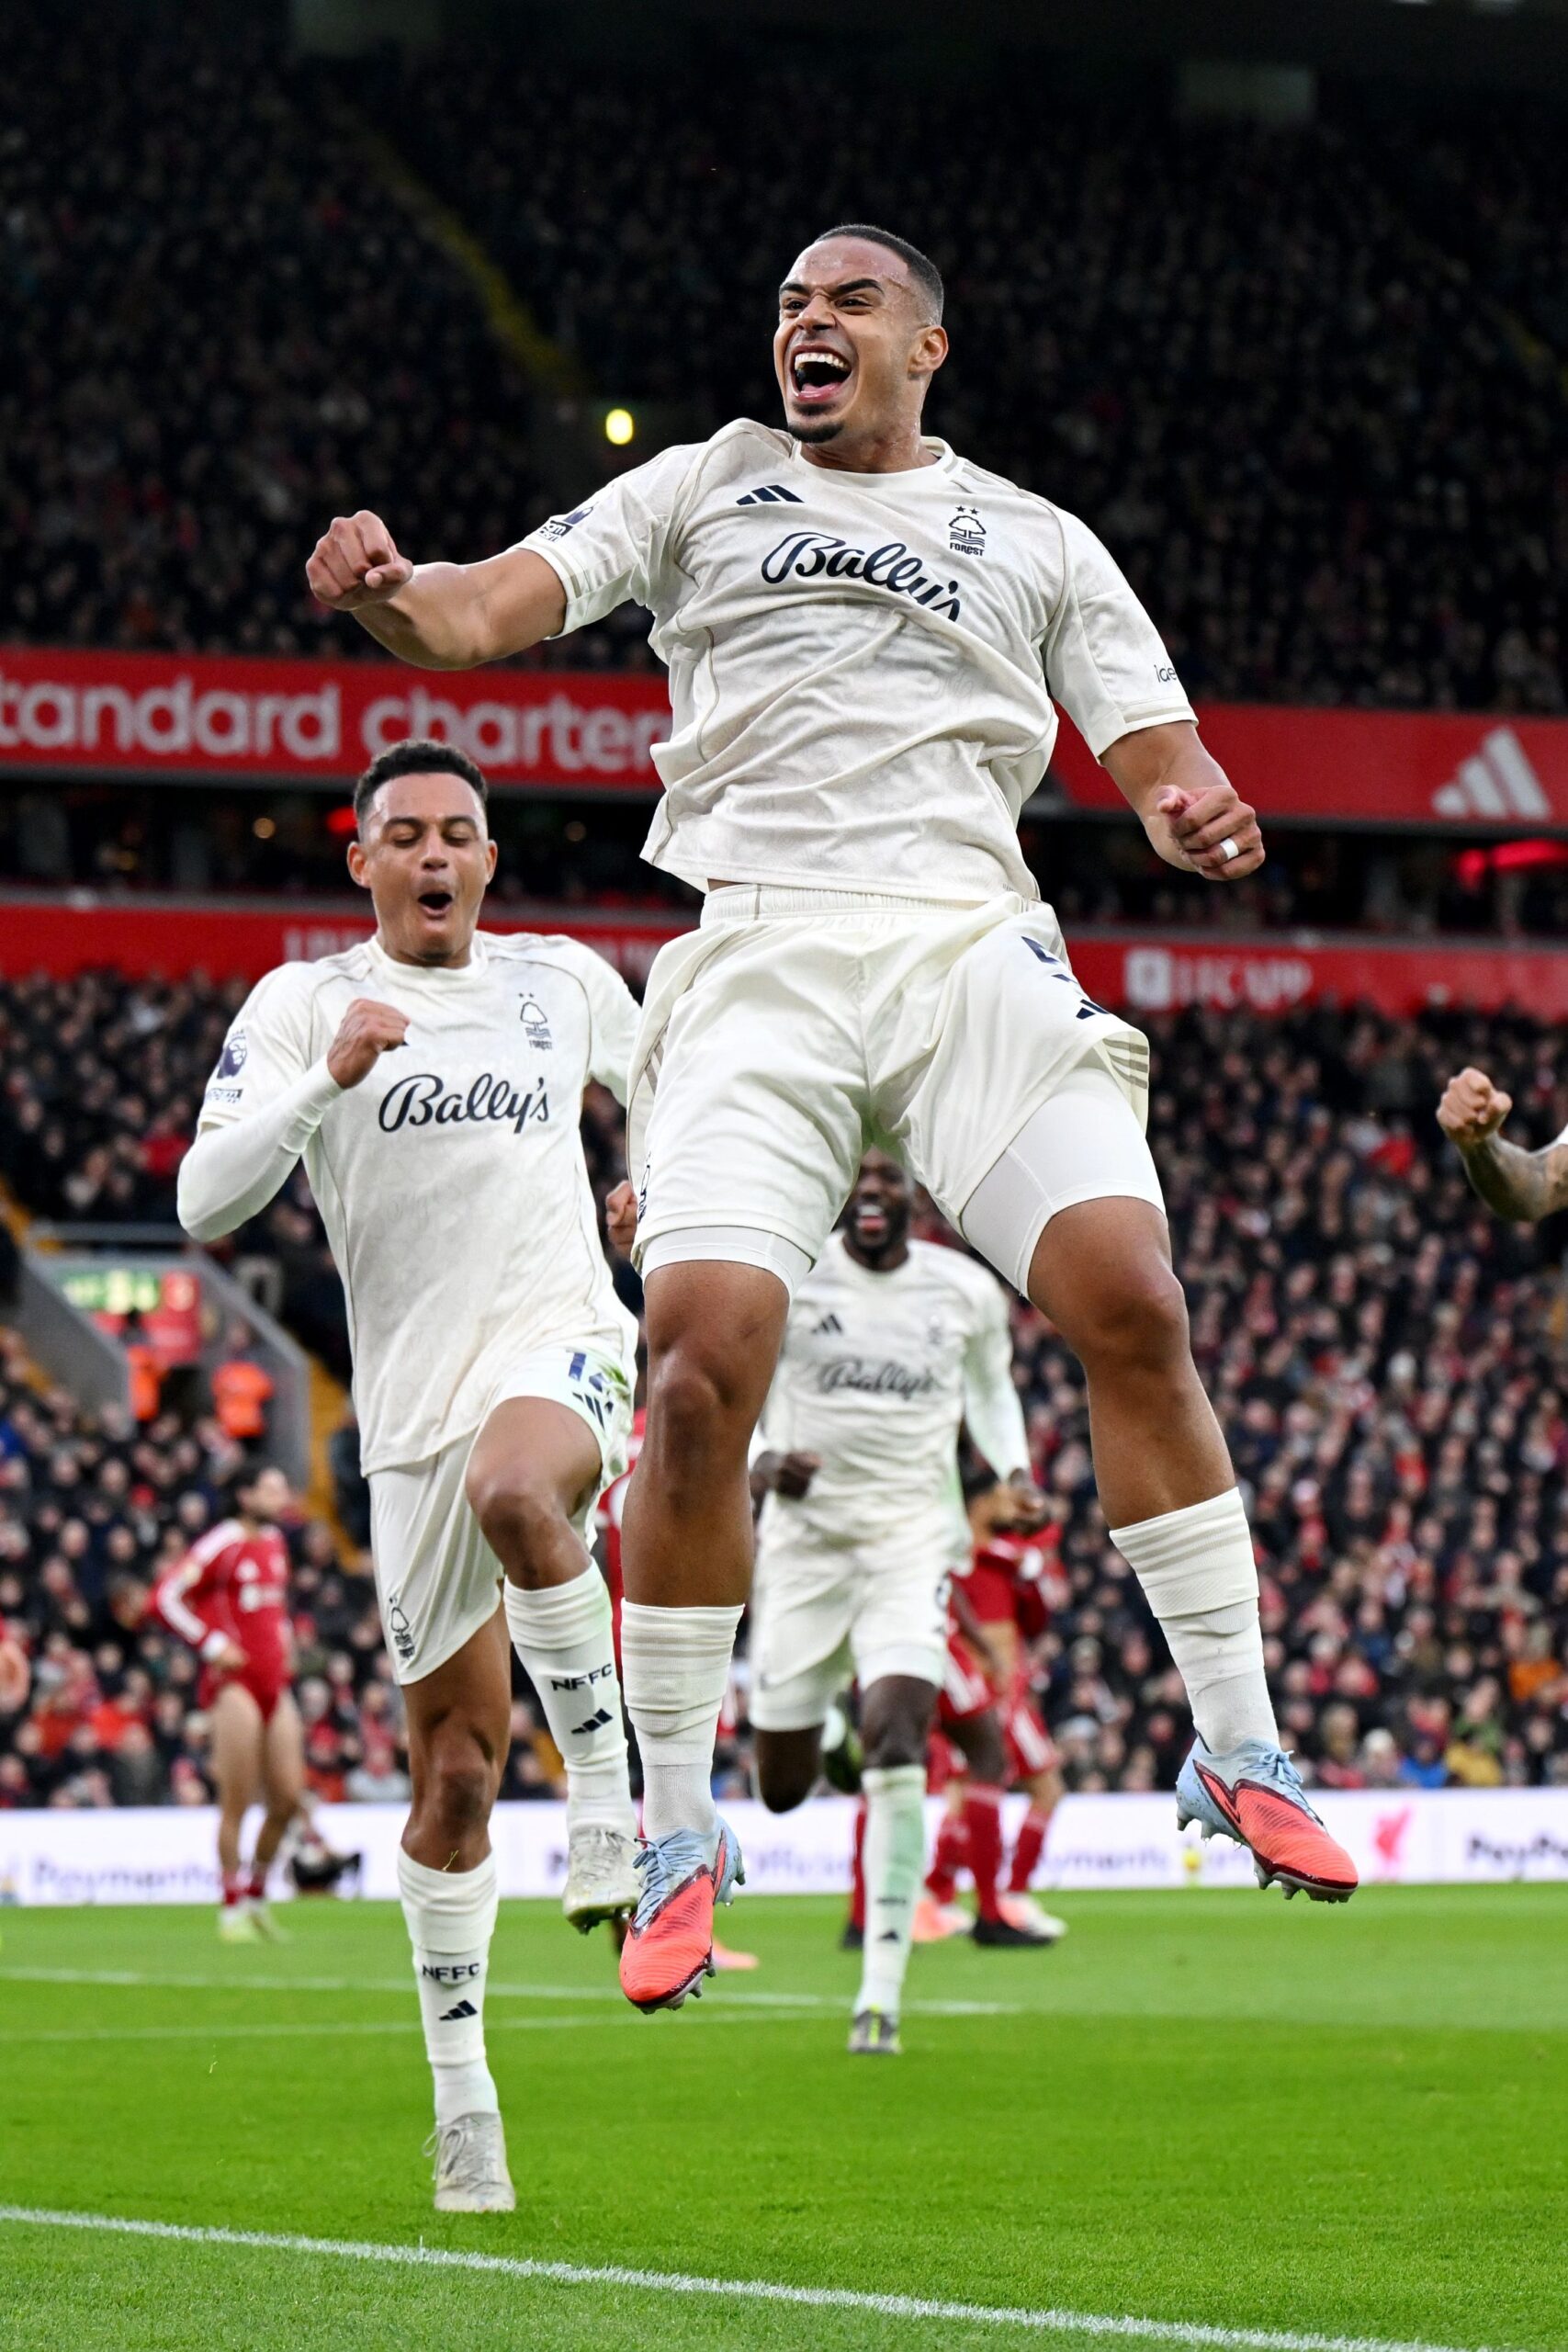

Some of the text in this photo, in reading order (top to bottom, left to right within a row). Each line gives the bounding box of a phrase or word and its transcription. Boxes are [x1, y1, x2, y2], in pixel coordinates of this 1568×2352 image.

[950, 542, 985, 556] FOREST
[378, 1073, 549, 1134] Bally's
[551, 1663, 613, 1690] NFFC
[422, 1962, 479, 1981] NFFC
